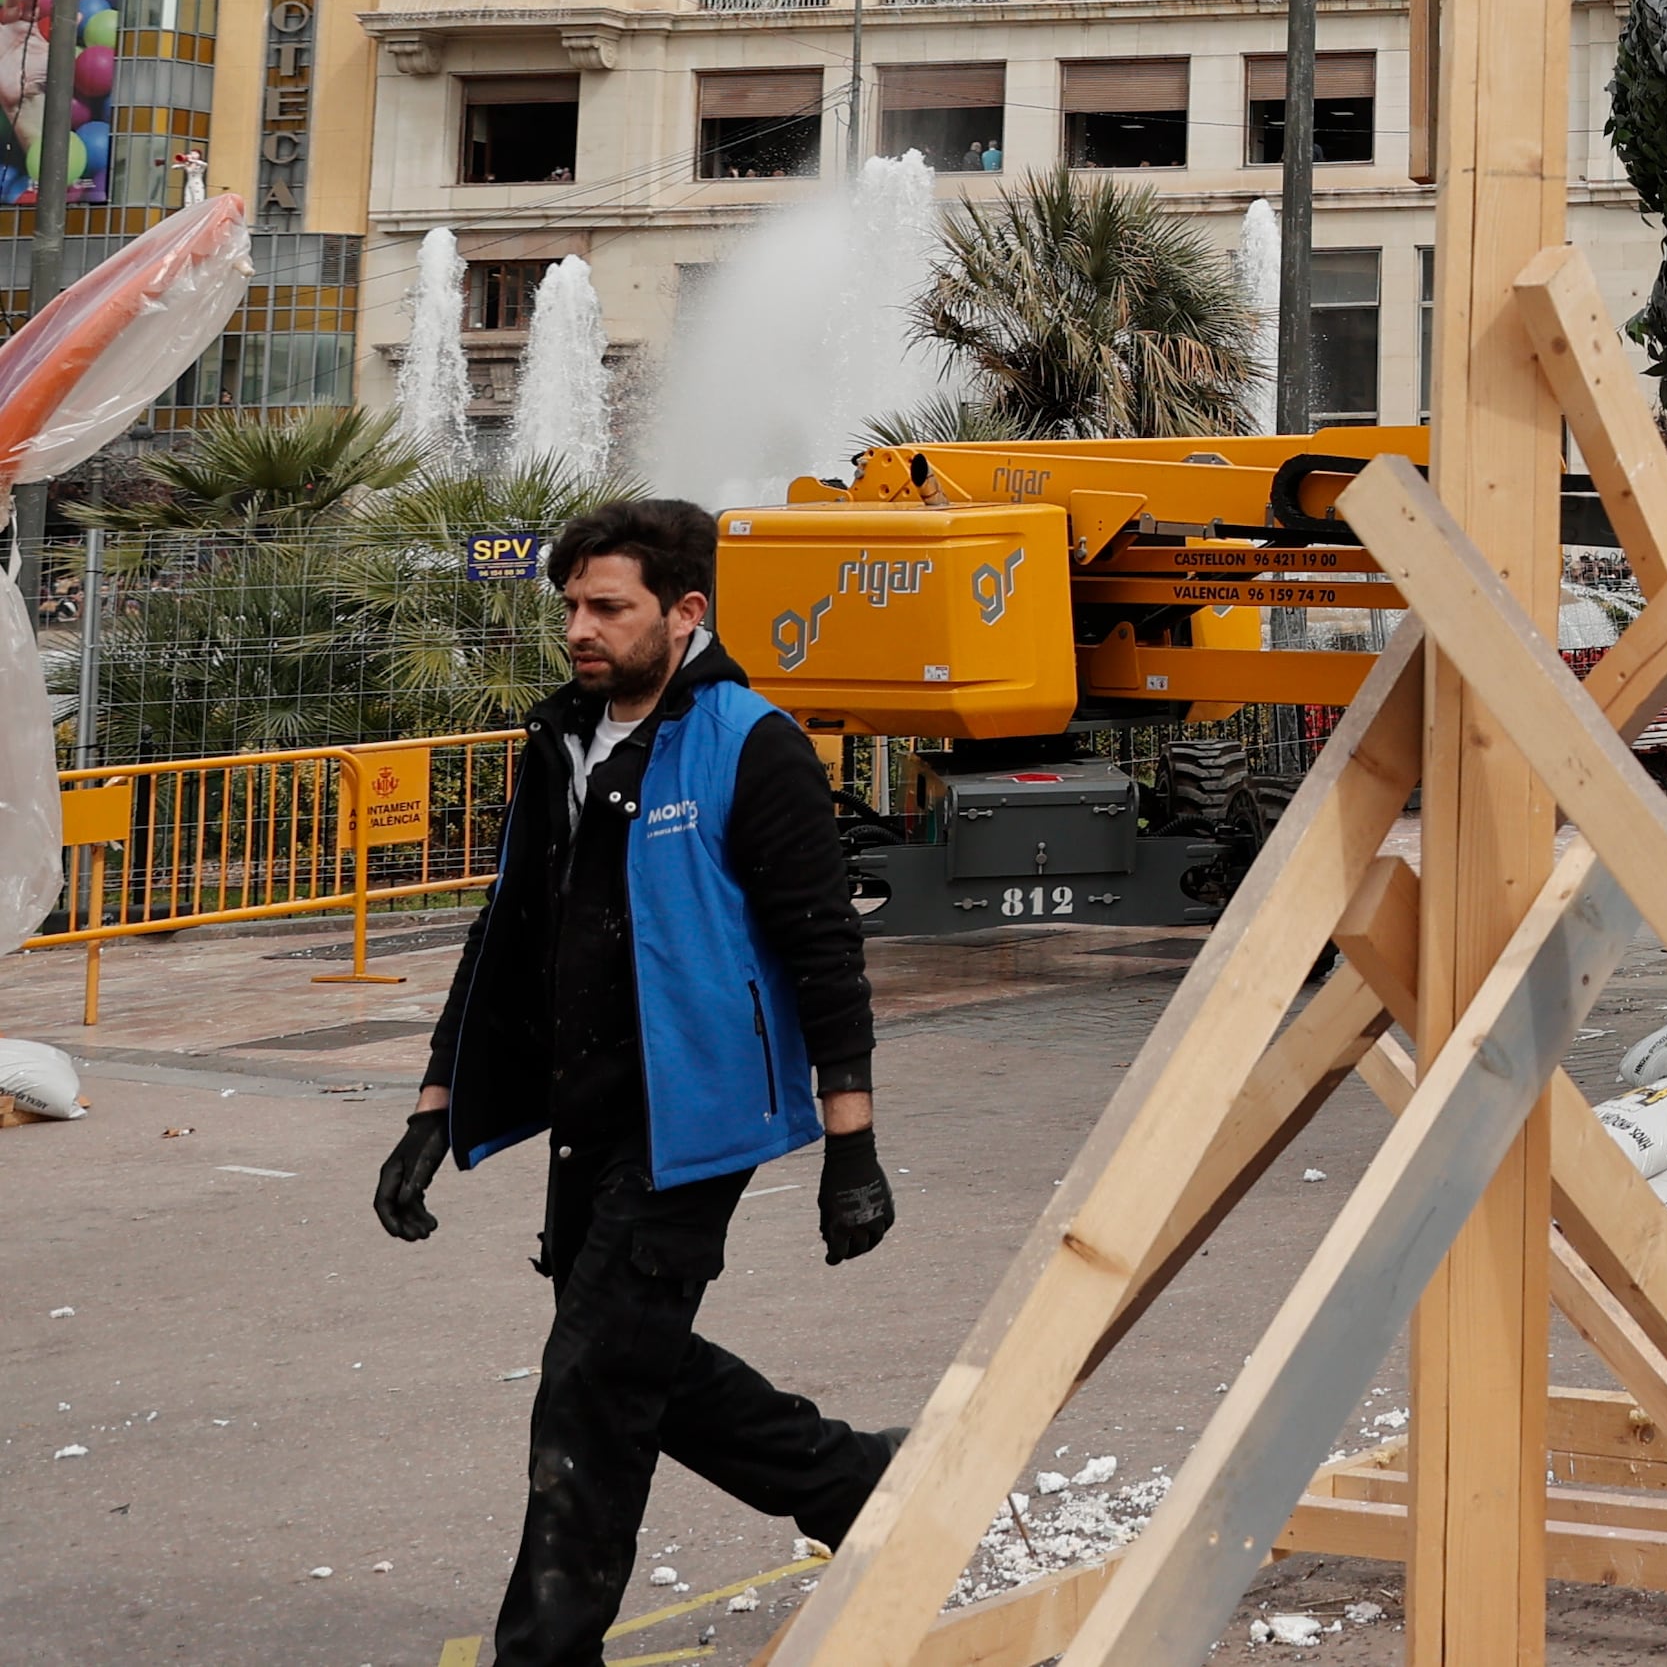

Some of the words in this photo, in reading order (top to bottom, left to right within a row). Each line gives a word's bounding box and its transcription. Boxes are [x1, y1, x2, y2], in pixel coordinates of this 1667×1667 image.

[992, 458, 1051, 503] rigar
[473, 538, 532, 560] SPV
[1174, 553, 1246, 566] CASTELLON
[1254, 553, 1269, 566] 96
[1274, 553, 1296, 566] 421
[1302, 553, 1317, 566] 19
[1321, 553, 1337, 566] 00
[838, 549, 933, 608] rigar
[971, 547, 1025, 626] gr
[1173, 586, 1240, 600] VALENCIA
[1248, 588, 1264, 601] 96
[1270, 588, 1293, 602] 159
[1298, 589, 1315, 602] 74
[1319, 589, 1336, 603] 70
[771, 594, 833, 673] gr
[349, 801, 421, 818] ANTAMENT
[366, 813, 421, 829] ALÈNCIA
[1001, 886, 1073, 916] 812
